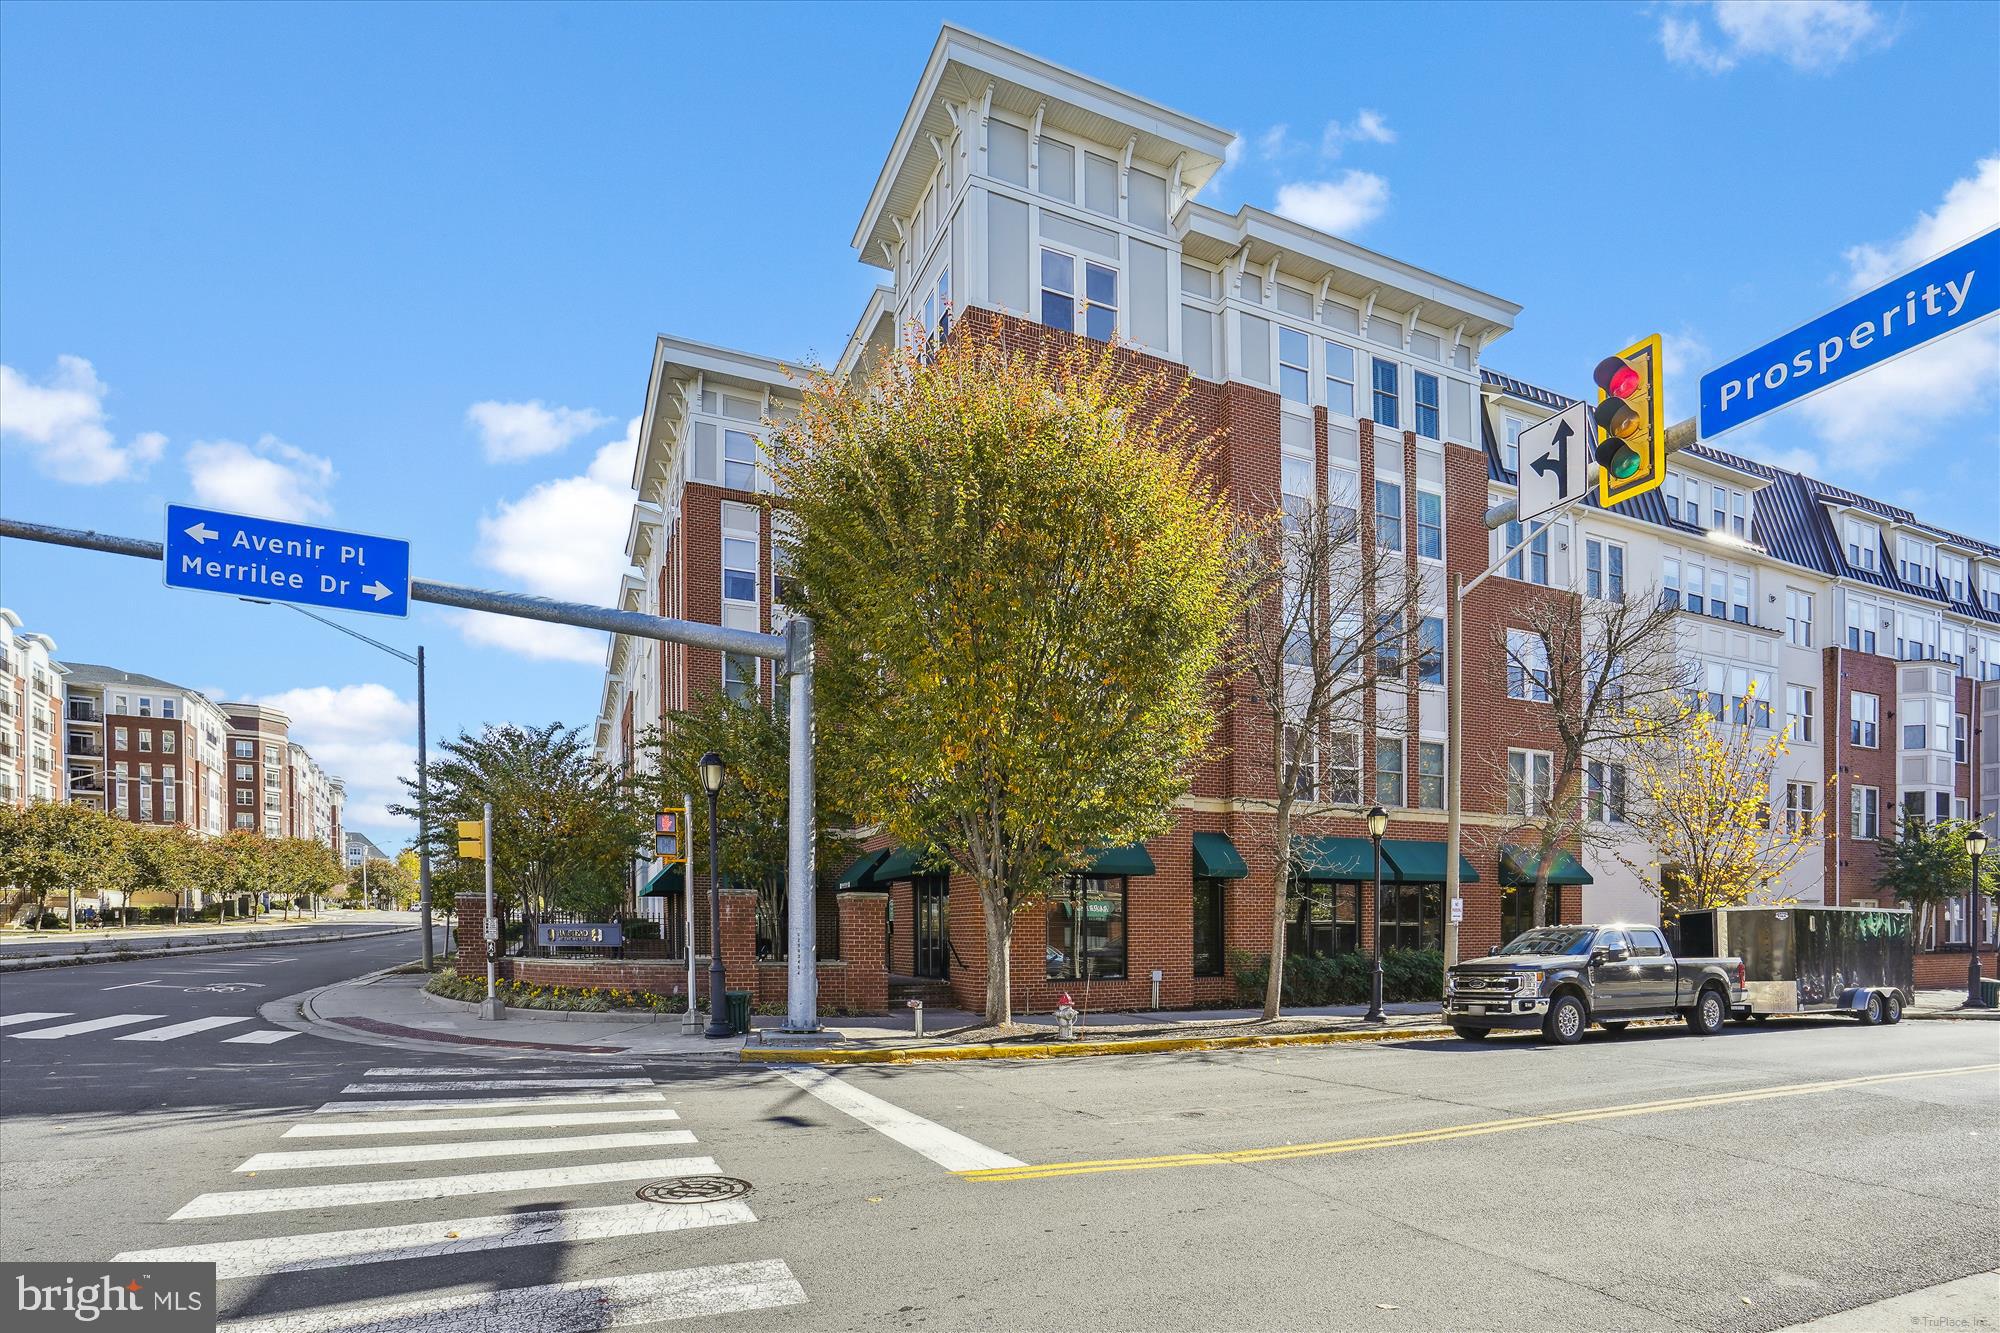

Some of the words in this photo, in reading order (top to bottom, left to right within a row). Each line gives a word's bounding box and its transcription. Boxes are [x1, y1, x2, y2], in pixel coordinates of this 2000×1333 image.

[1719, 270, 1976, 412] Prosperity
[232, 530, 325, 560] Avenir
[341, 546, 365, 566] Pl
[182, 555, 304, 589] Merrilee
[320, 574, 350, 595] Dr
